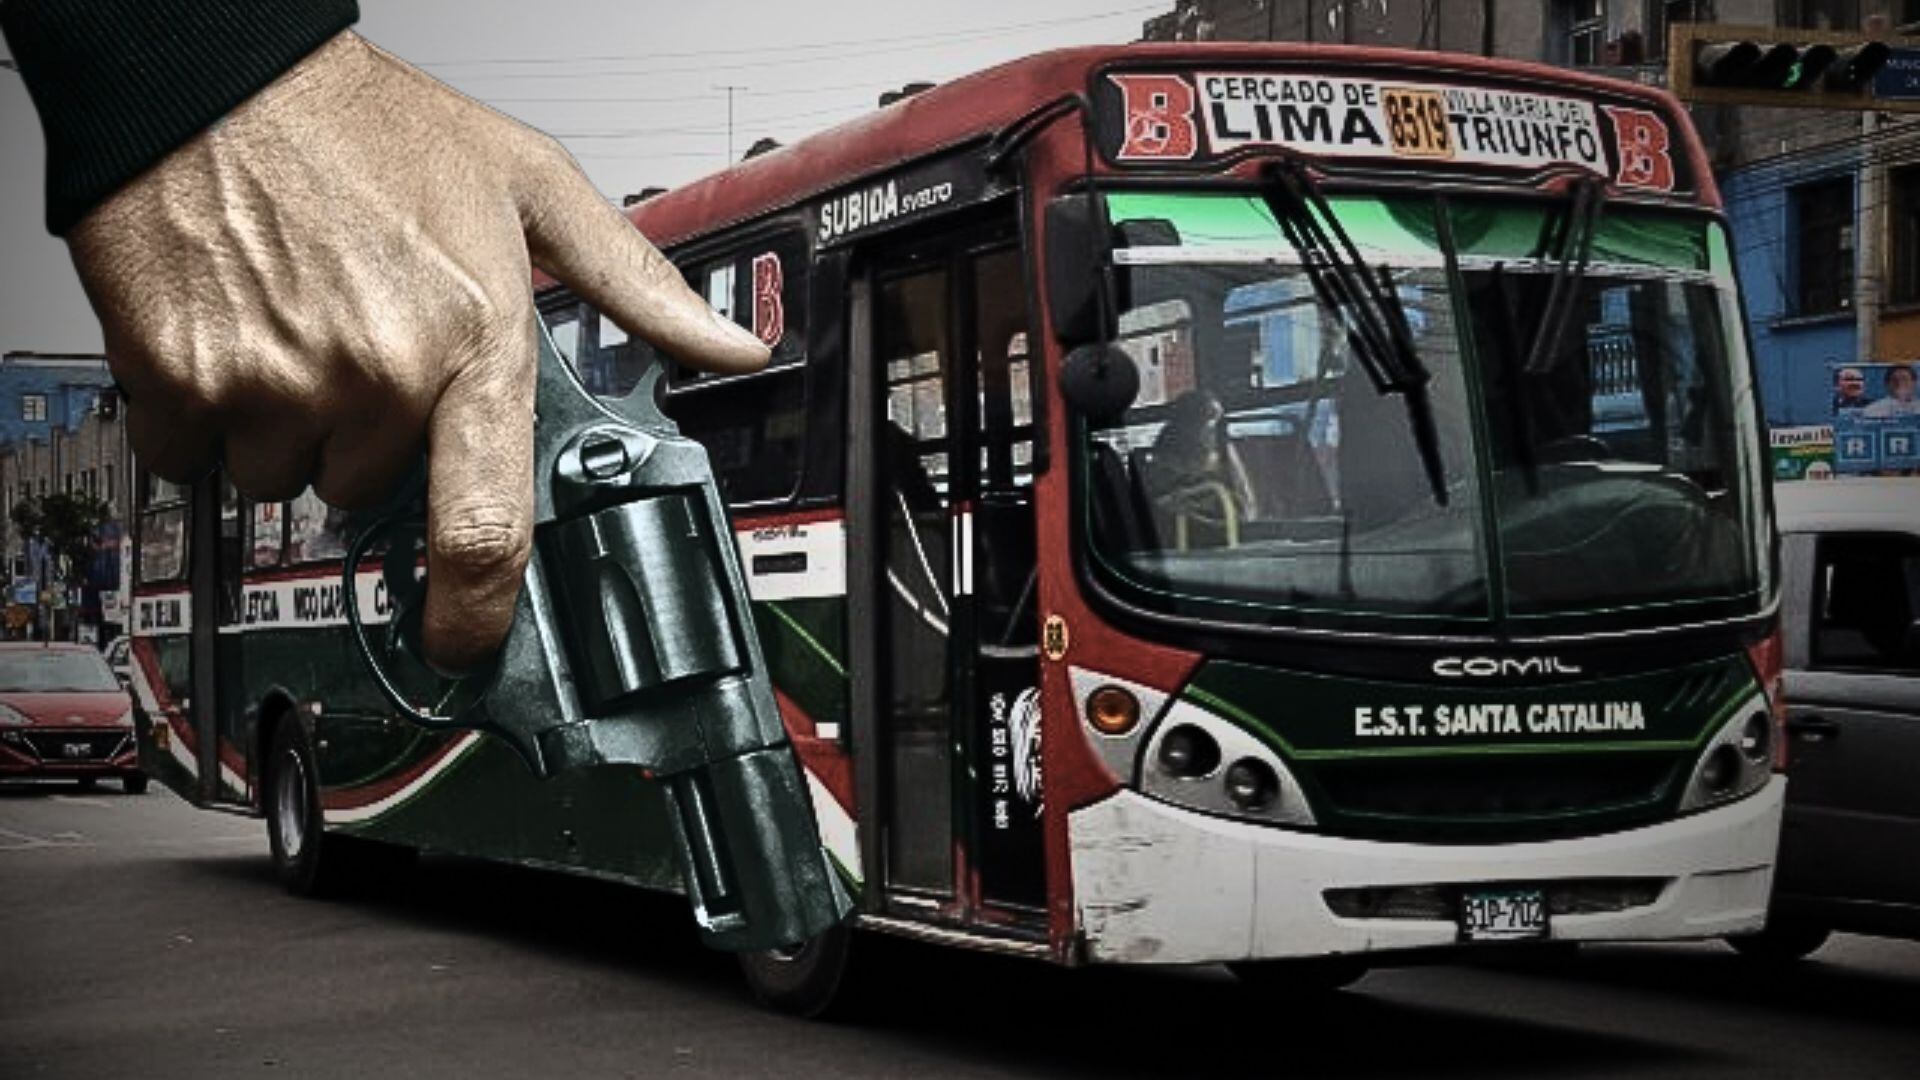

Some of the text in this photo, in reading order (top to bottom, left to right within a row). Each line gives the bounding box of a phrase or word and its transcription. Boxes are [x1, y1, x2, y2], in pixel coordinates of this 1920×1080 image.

[1205, 77, 1378, 107] CERCADO DE
[1442, 89, 1590, 126] VILLA MARIA DEL
[1108, 74, 1198, 160] B
[1209, 101, 1383, 145] LIMA
[1385, 93, 1448, 150] 8519
[1449, 114, 1596, 162] TRIUNFO
[1607, 105, 1674, 191] B
[819, 180, 898, 239] SUBIDA
[752, 252, 784, 348] B
[1433, 656, 1581, 676] COMIL
[1354, 701, 1644, 736] E.S.T. SANTA CATALINA
